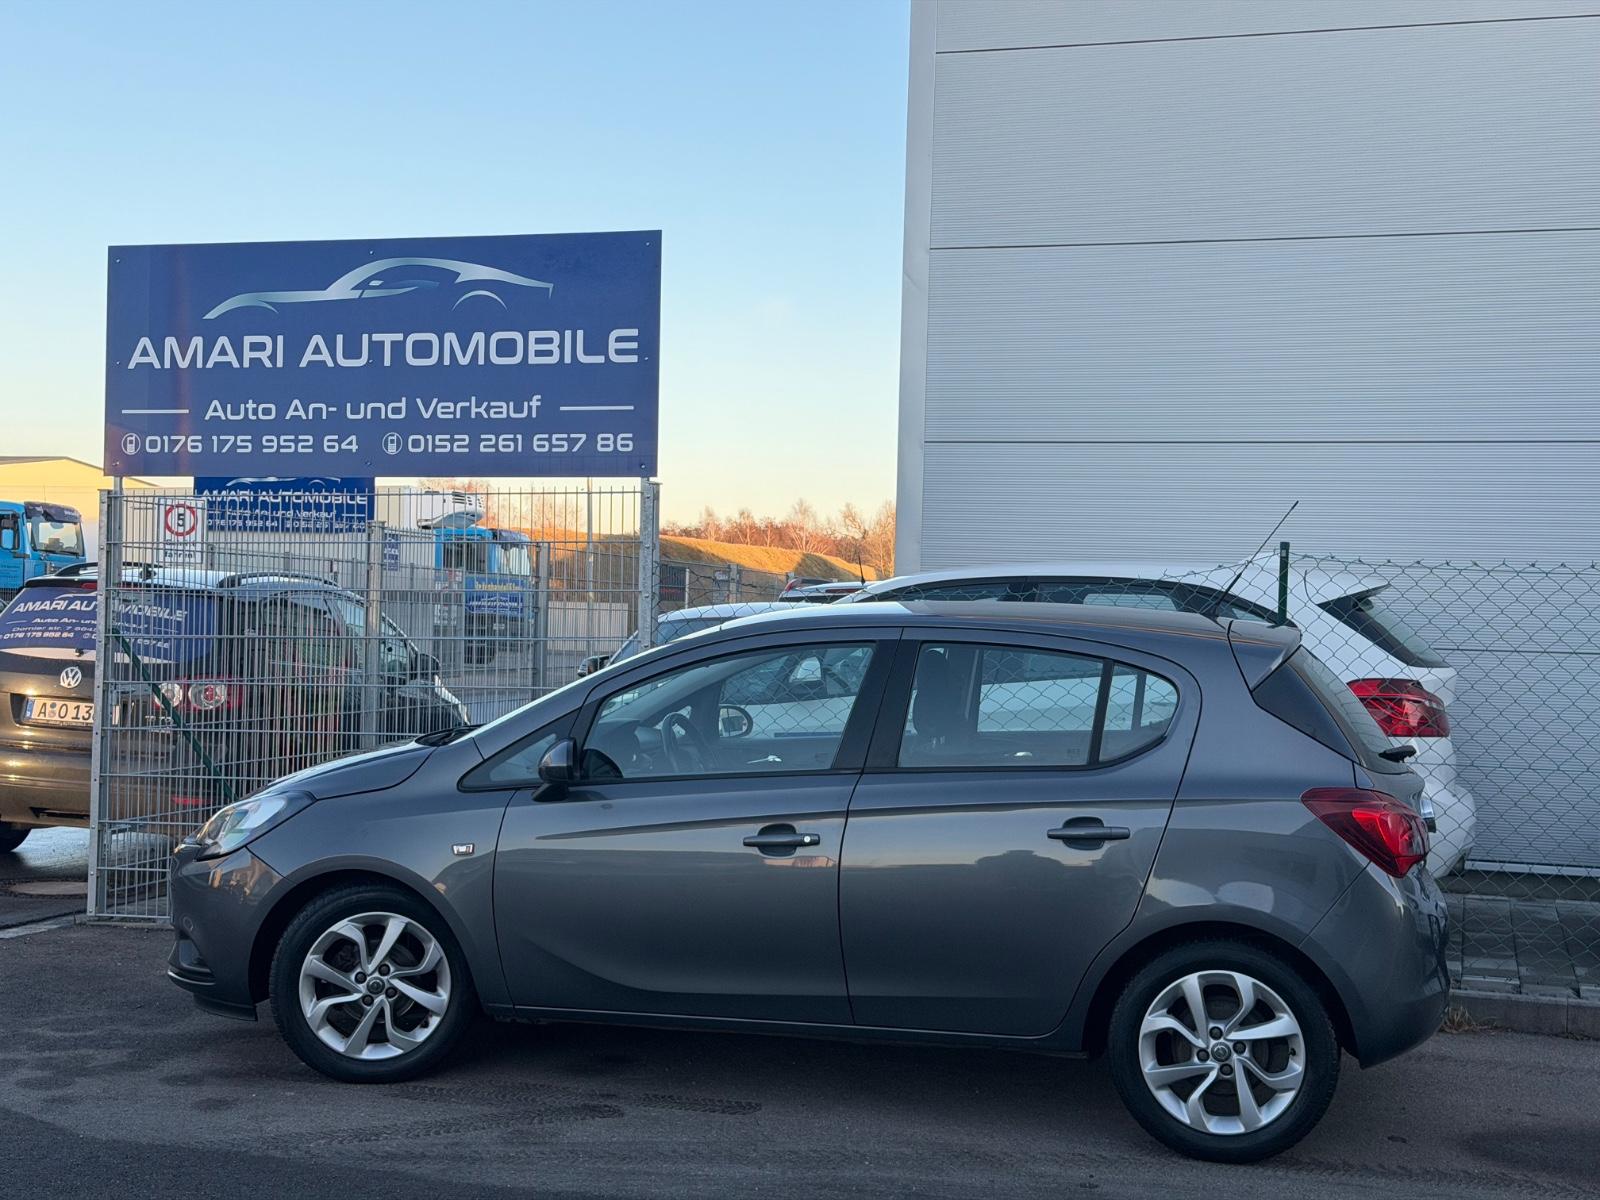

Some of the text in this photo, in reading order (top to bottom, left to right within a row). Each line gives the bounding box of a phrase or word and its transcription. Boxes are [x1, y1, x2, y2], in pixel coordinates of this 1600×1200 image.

[127, 328, 640, 370] AMARI AUTOMOBILE
[204, 395, 542, 421] Auto An- und Verkauf
[145, 434, 359, 454] 0176 175 952 64
[407, 433, 634, 453] 0152 261 657 86
[201, 489, 368, 504] AMARI AUTOMOBILE
[12, 600, 68, 614] AMARI
[37, 702, 47, 717] A
